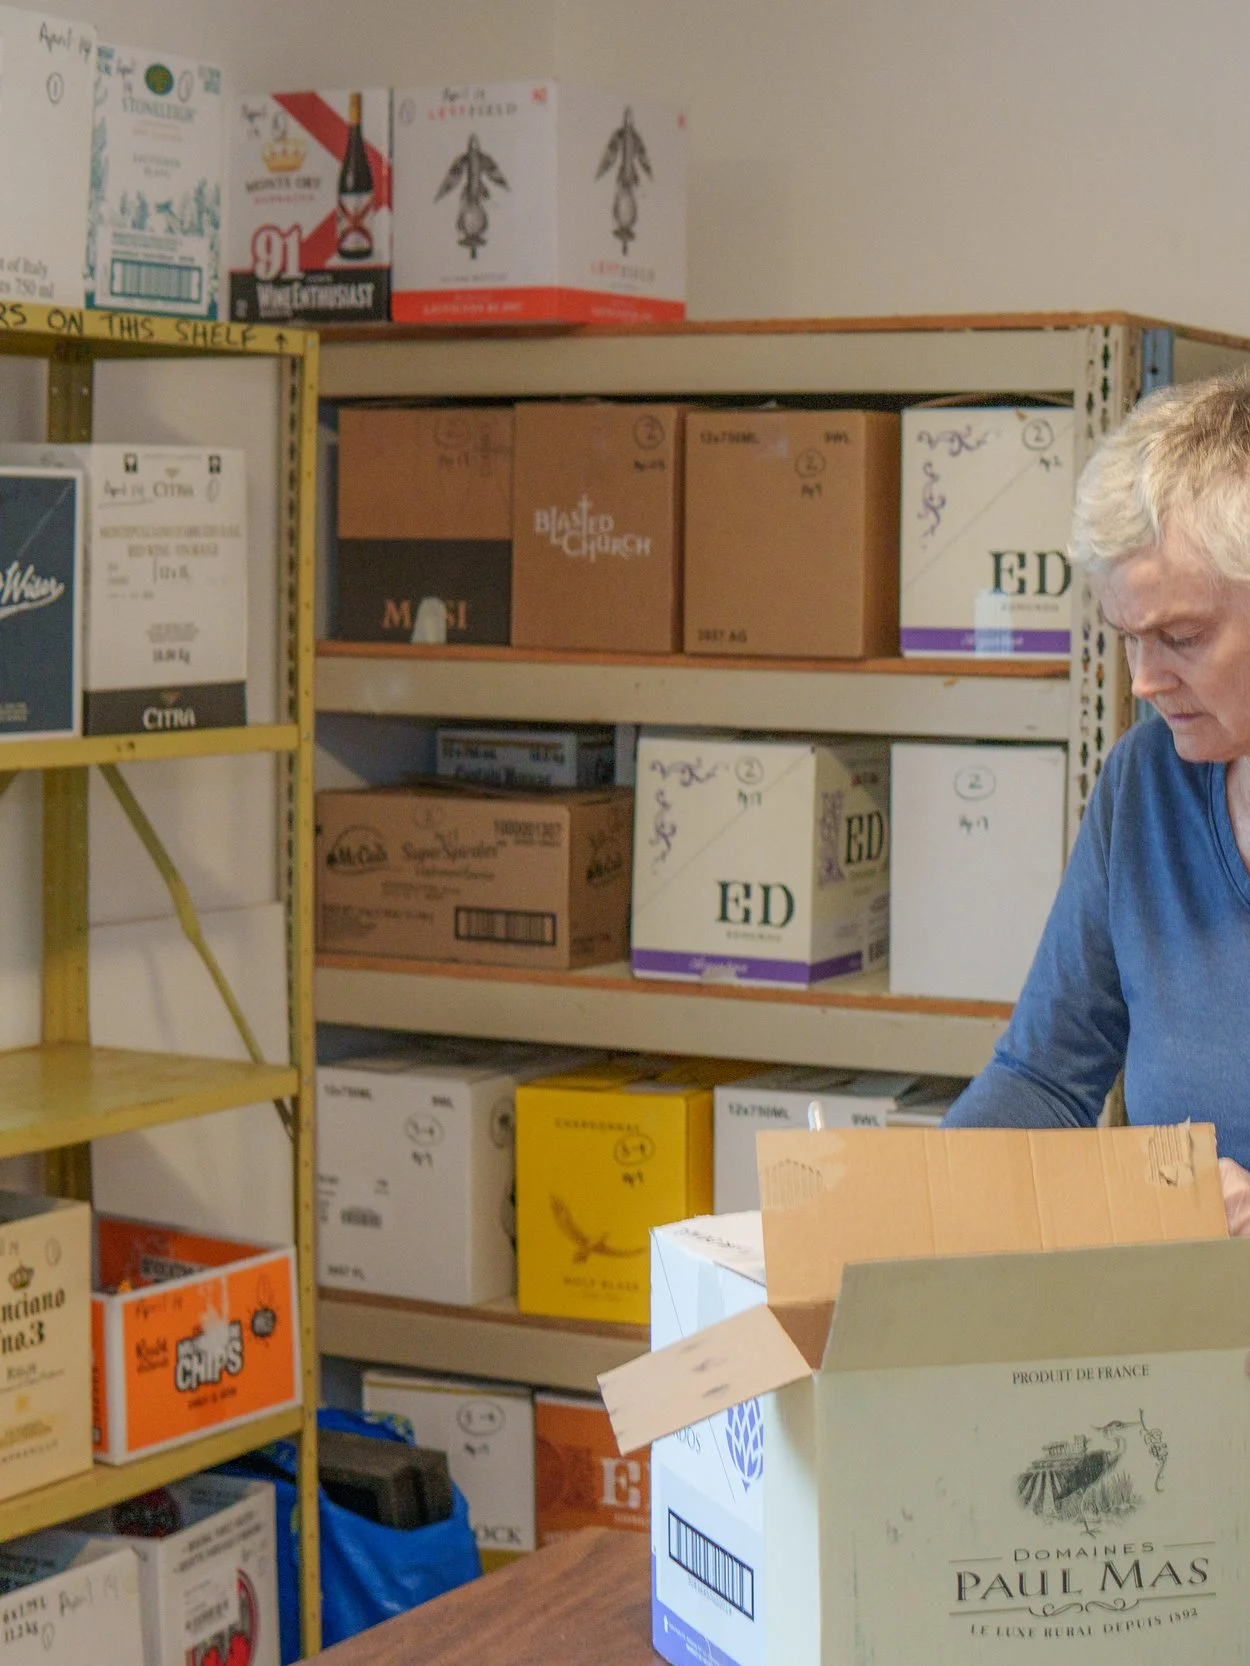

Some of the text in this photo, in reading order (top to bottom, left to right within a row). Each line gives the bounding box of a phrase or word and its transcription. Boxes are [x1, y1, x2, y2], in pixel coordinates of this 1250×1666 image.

[252, 221, 302, 283] 91
[47, 307, 84, 336] ON
[100, 311, 154, 342] THIS
[175, 318, 256, 350] SHELF
[990, 550, 1072, 598] ED
[142, 706, 197, 730] CITRA
[715, 879, 796, 929] ED
[1012, 1363, 1150, 1386] PRODUIT DE FRANCE
[602, 1457, 650, 1510] E
[1014, 1541, 1155, 1562] DOMAINES
[956, 1557, 1210, 1601] PAUL MAS
[970, 1607, 1198, 1639] LE LUXE RURAL DEPUIS 1892
